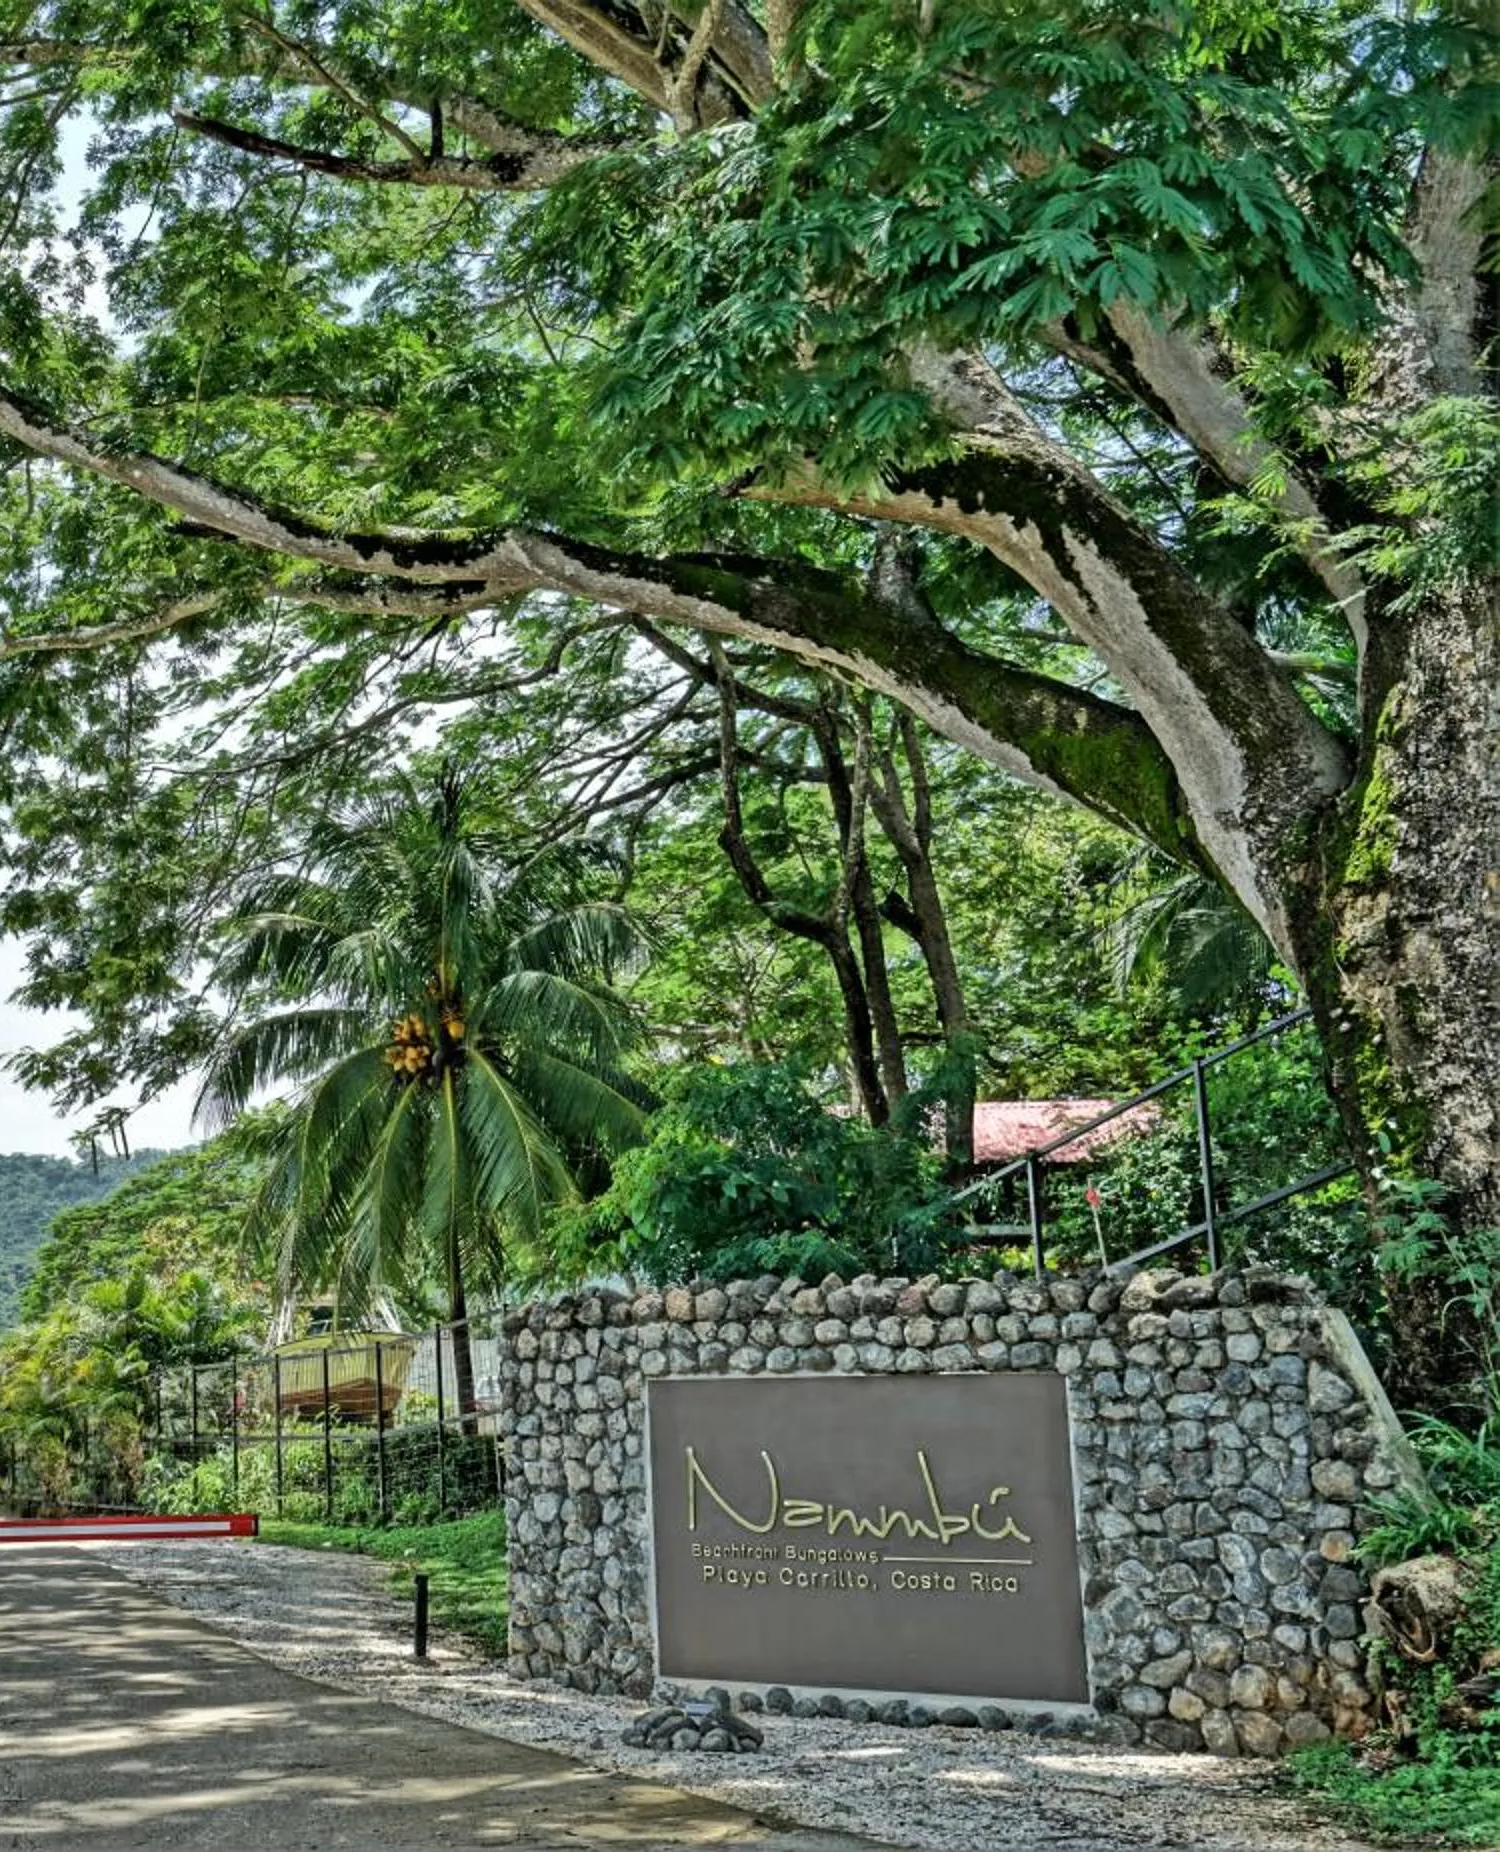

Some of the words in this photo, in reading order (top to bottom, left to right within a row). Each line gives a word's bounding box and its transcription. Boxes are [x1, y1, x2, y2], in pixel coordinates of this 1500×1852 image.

[691, 1543, 778, 1560] Beachfront
[785, 1545, 879, 1565] Bungalows
[703, 1565, 767, 1588] Playa
[779, 1567, 878, 1591] Carrillo,
[891, 1570, 955, 1591] Costa
[969, 1571, 1018, 1593] Rica
